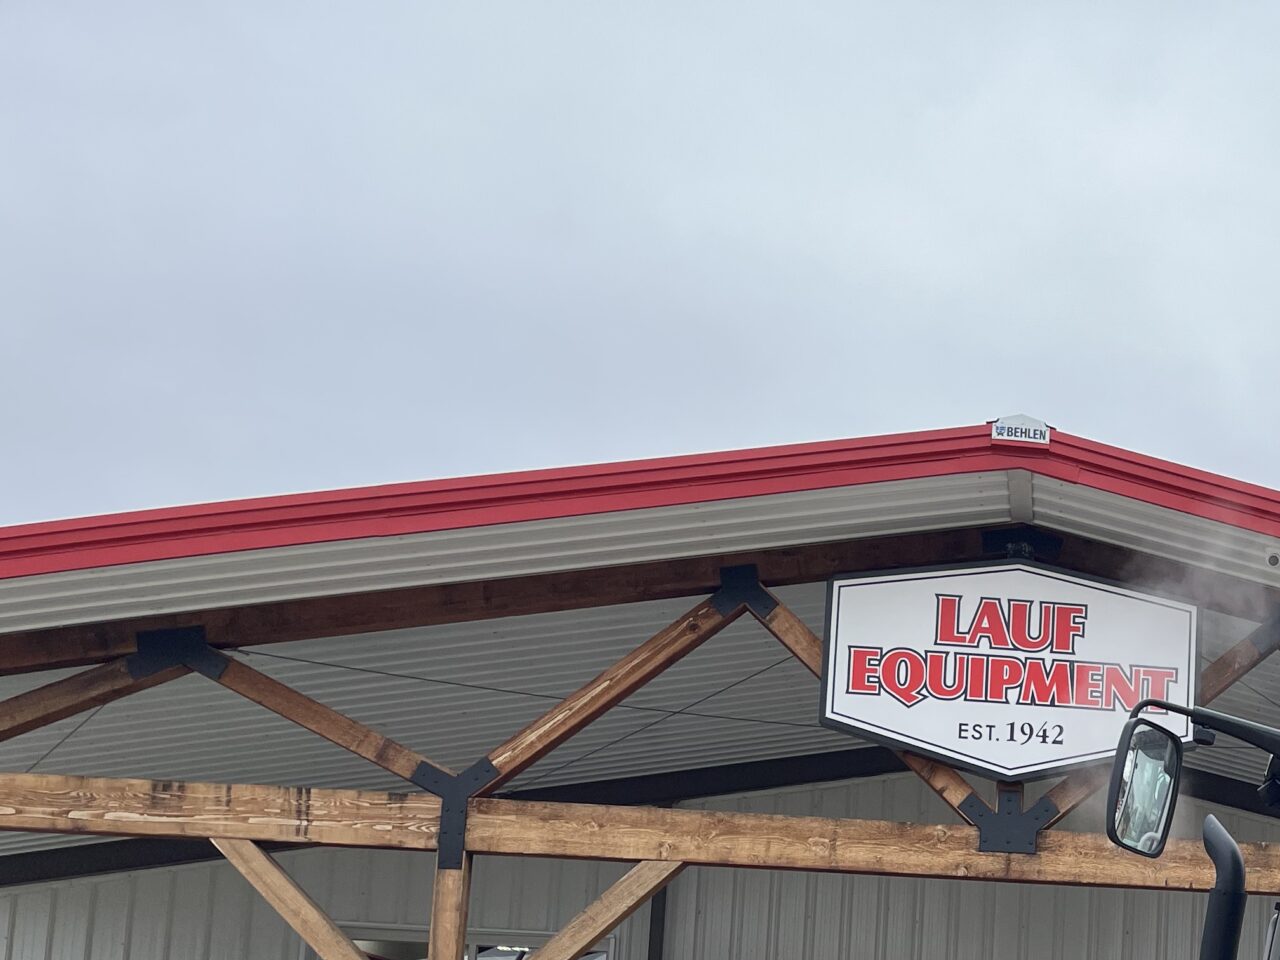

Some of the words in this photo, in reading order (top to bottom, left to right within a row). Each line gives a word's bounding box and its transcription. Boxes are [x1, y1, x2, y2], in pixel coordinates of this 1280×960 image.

[1006, 426, 1046, 440] BEHLEN
[934, 593, 1087, 654] LAUF
[846, 645, 1179, 714] EQUIPMENT
[958, 722, 999, 742] EST.
[1006, 721, 1064, 746] 1942
